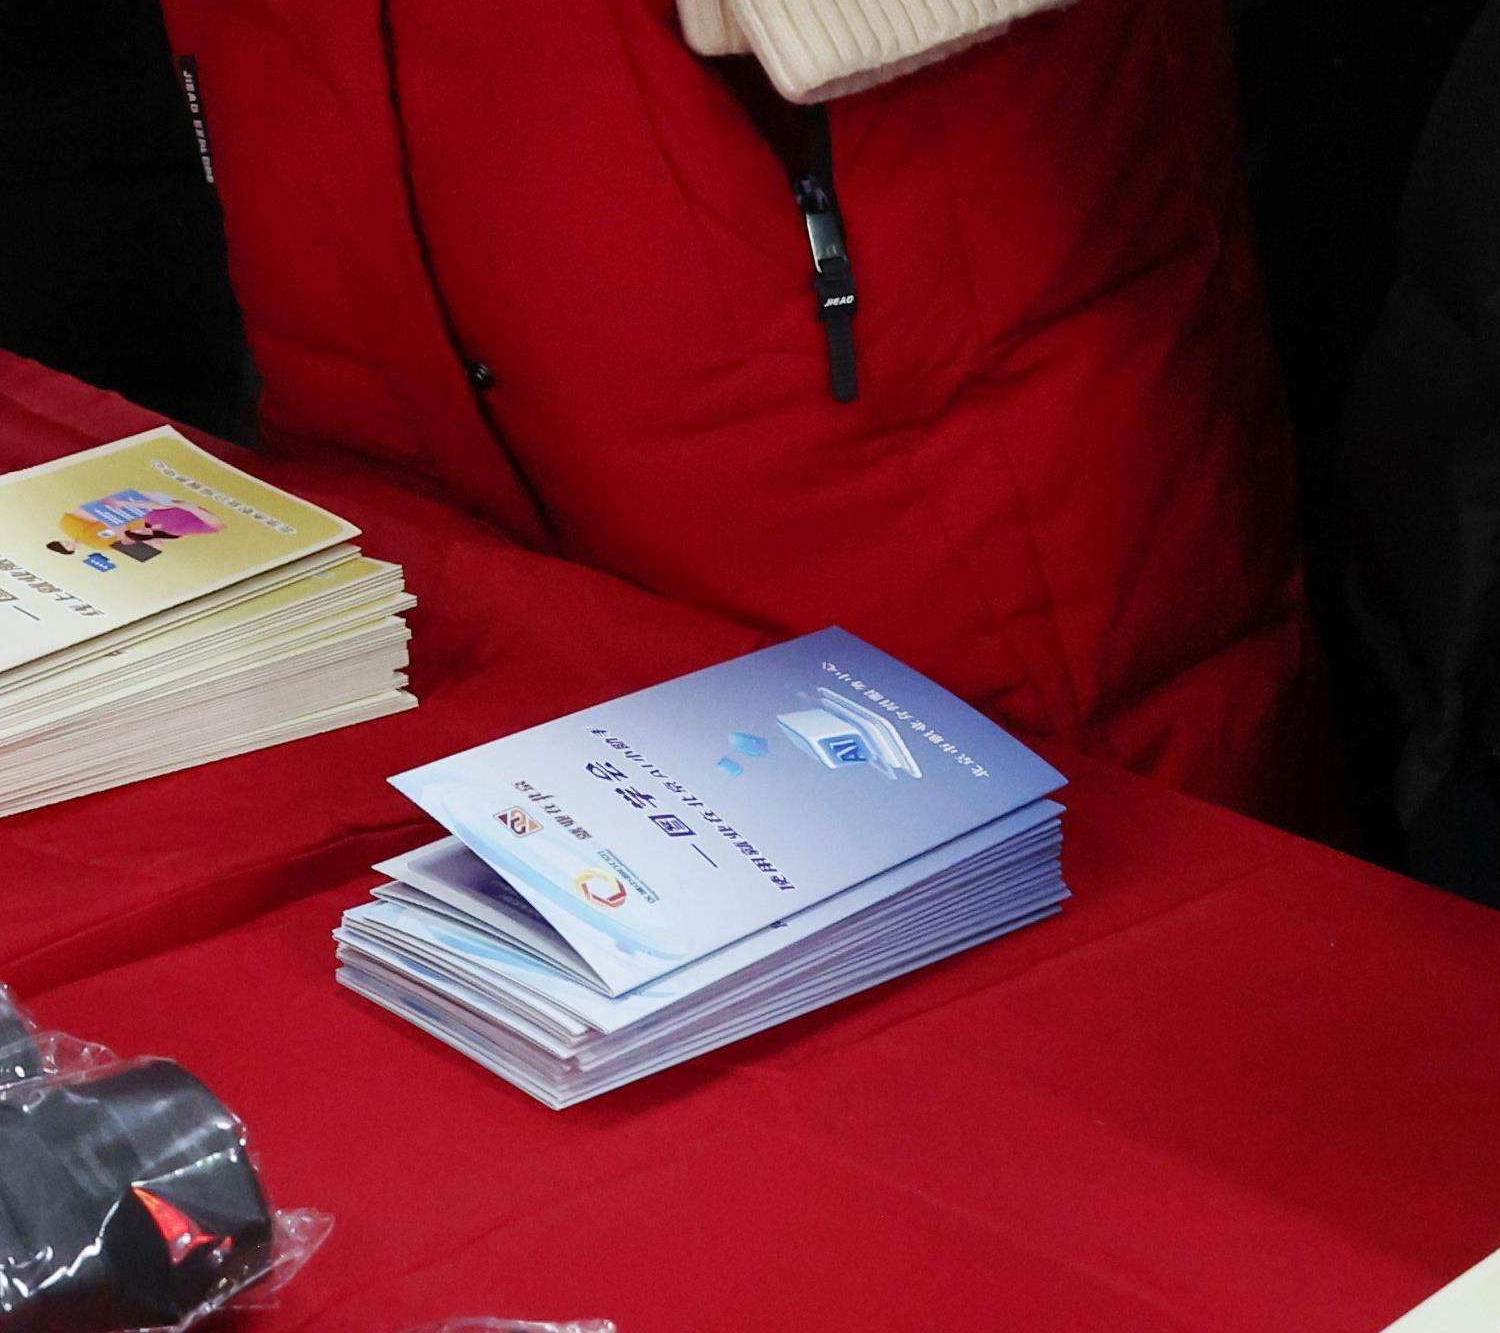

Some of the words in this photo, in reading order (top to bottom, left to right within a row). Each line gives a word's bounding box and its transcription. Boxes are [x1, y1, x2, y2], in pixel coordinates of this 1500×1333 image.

[512, 779, 596, 843] 就业在北京
[584, 759, 720, 870] 一图学会
[587, 724, 795, 894] 使用就业在北京AI小助手
